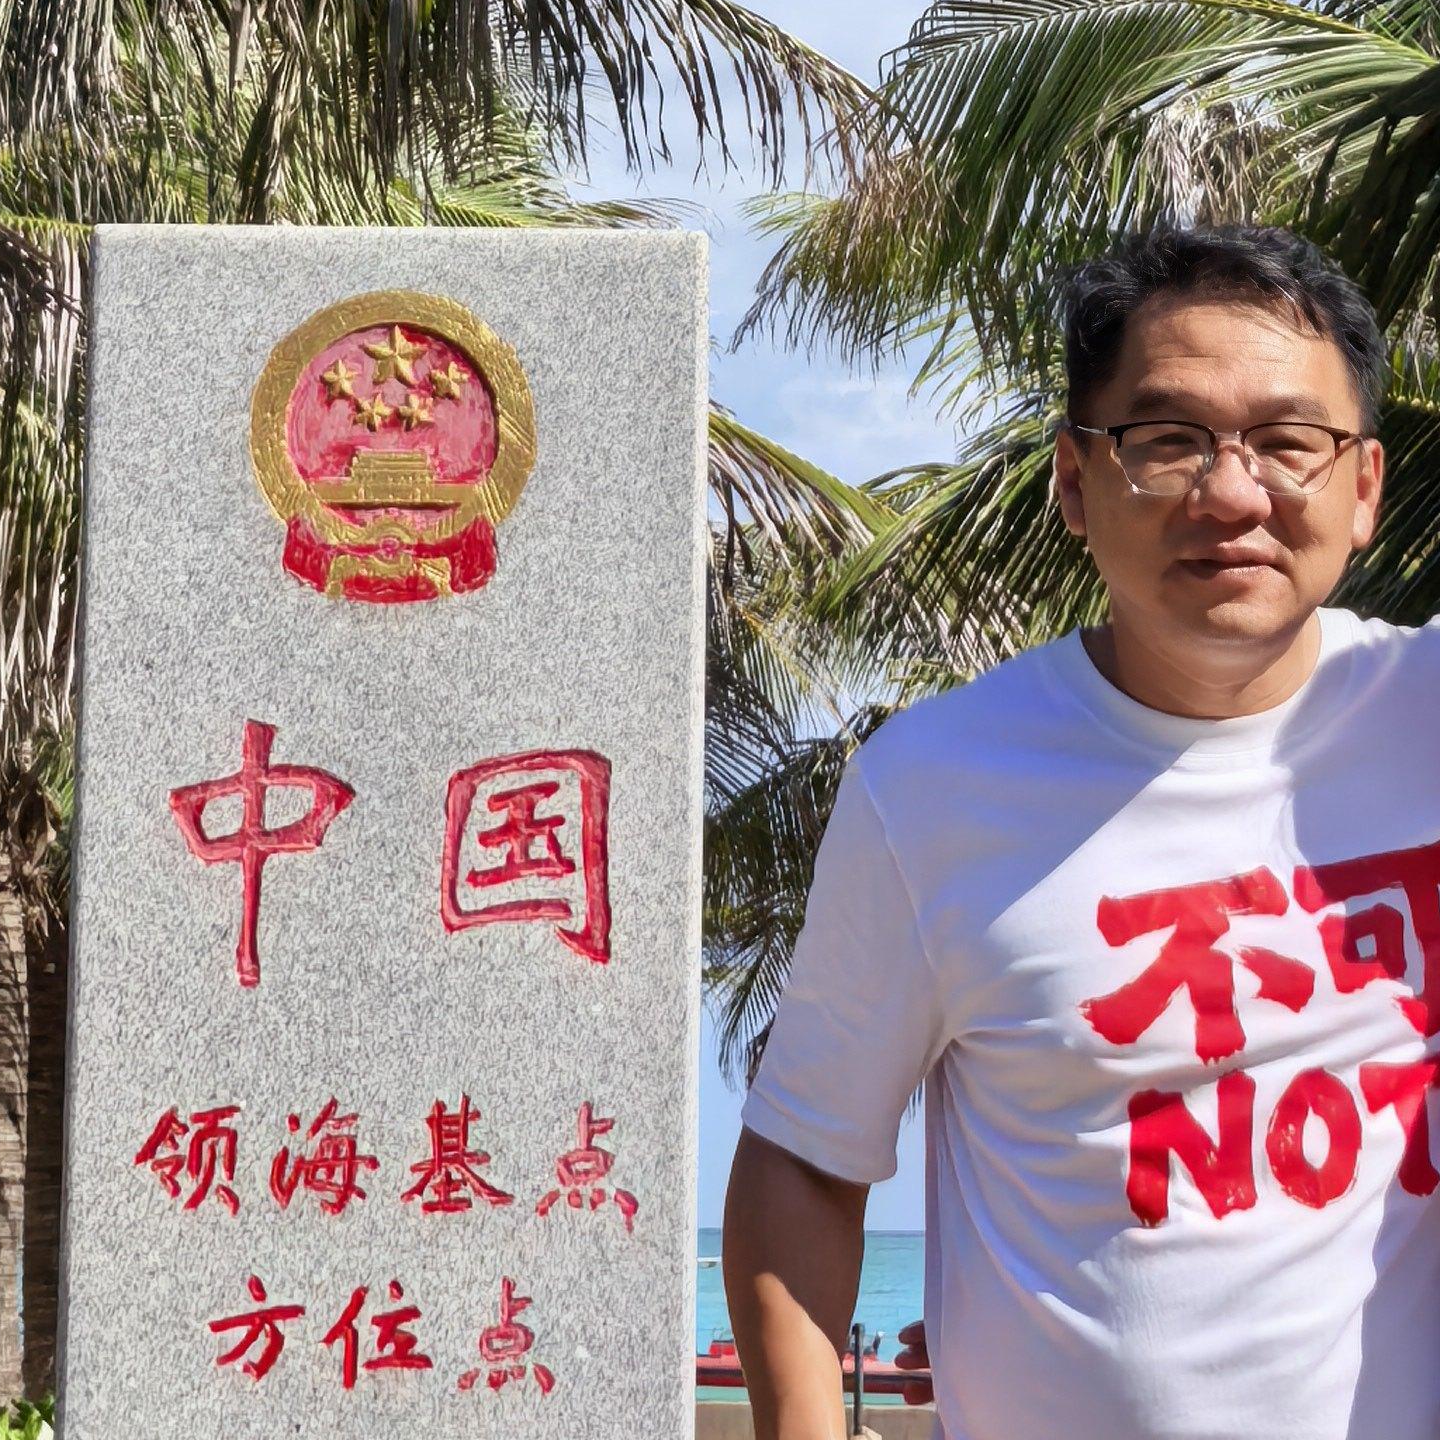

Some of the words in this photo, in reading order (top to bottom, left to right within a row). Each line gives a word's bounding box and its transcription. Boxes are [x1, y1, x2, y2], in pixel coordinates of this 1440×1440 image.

[168, 719, 613, 989] 中国
[133, 1092, 640, 1232] 领海基点
[208, 1274, 556, 1395] 方位点
